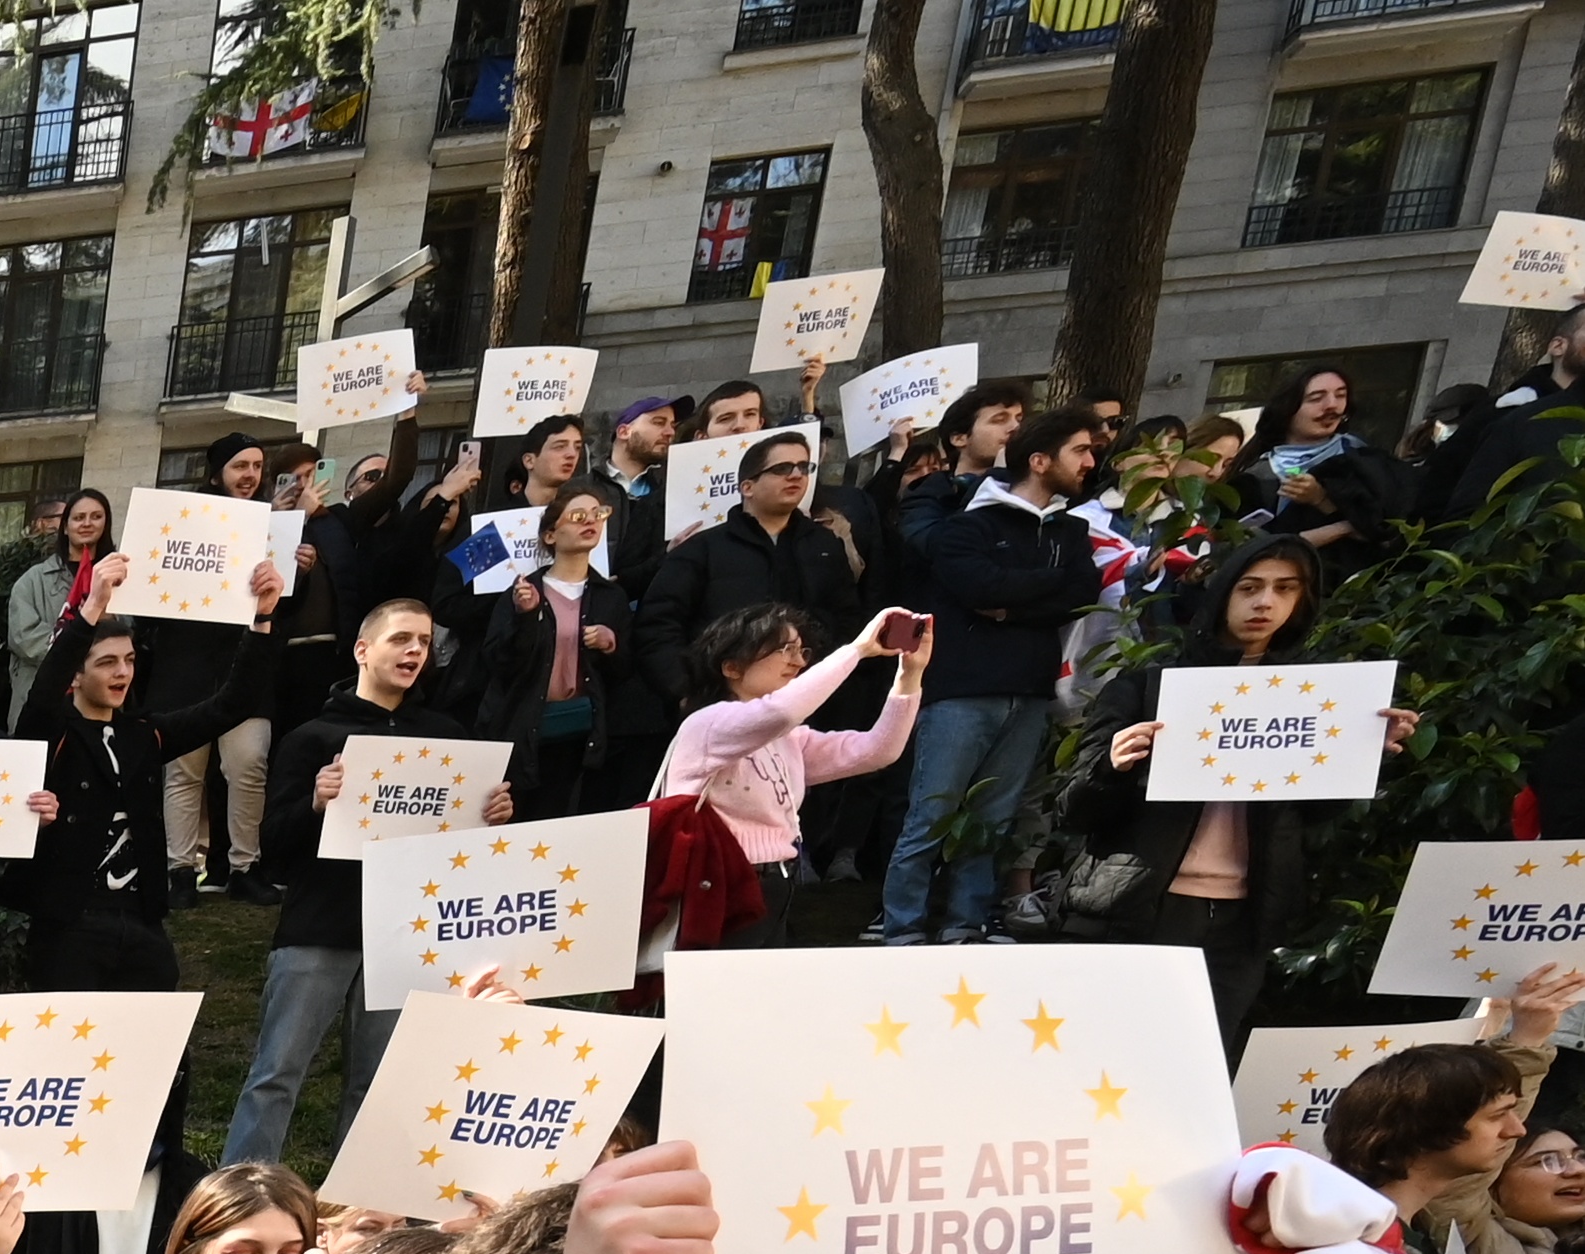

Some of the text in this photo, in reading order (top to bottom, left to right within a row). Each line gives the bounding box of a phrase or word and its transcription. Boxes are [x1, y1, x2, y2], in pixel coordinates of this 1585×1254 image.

[1518, 249, 1541, 261] WE
[1512, 260, 1566, 274] EUROPE
[799, 306, 849, 322] WE ARE
[796, 318, 847, 334] EUROPE
[333, 365, 383, 382] WE ARE
[333, 375, 383, 393] EUROPE
[518, 380, 567, 390] WE ARE
[879, 377, 939, 400] WE ARE
[516, 390, 566, 402] EUROPE
[880, 386, 940, 410] EUROPE
[710, 472, 735, 486] WE
[709, 483, 740, 498] EUR
[167, 539, 228, 558] WE ARE
[161, 555, 224, 574] EUROPE
[1221, 716, 1317, 733] WE ARE
[1218, 733, 1316, 749] EUROPE
[378, 784, 449, 801] WE ARE
[373, 800, 445, 816] EUROPE
[437, 889, 557, 920] WE ARE
[1488, 904, 1542, 922] WE
[437, 912, 557, 941] EUROPE
[1478, 924, 1585, 942] EUROP
[16, 1077, 86, 1101] ARE
[465, 1089, 576, 1124] WE ARE
[450, 1118, 565, 1150] EUROPE
[845, 1139, 1088, 1205] WE ARE
